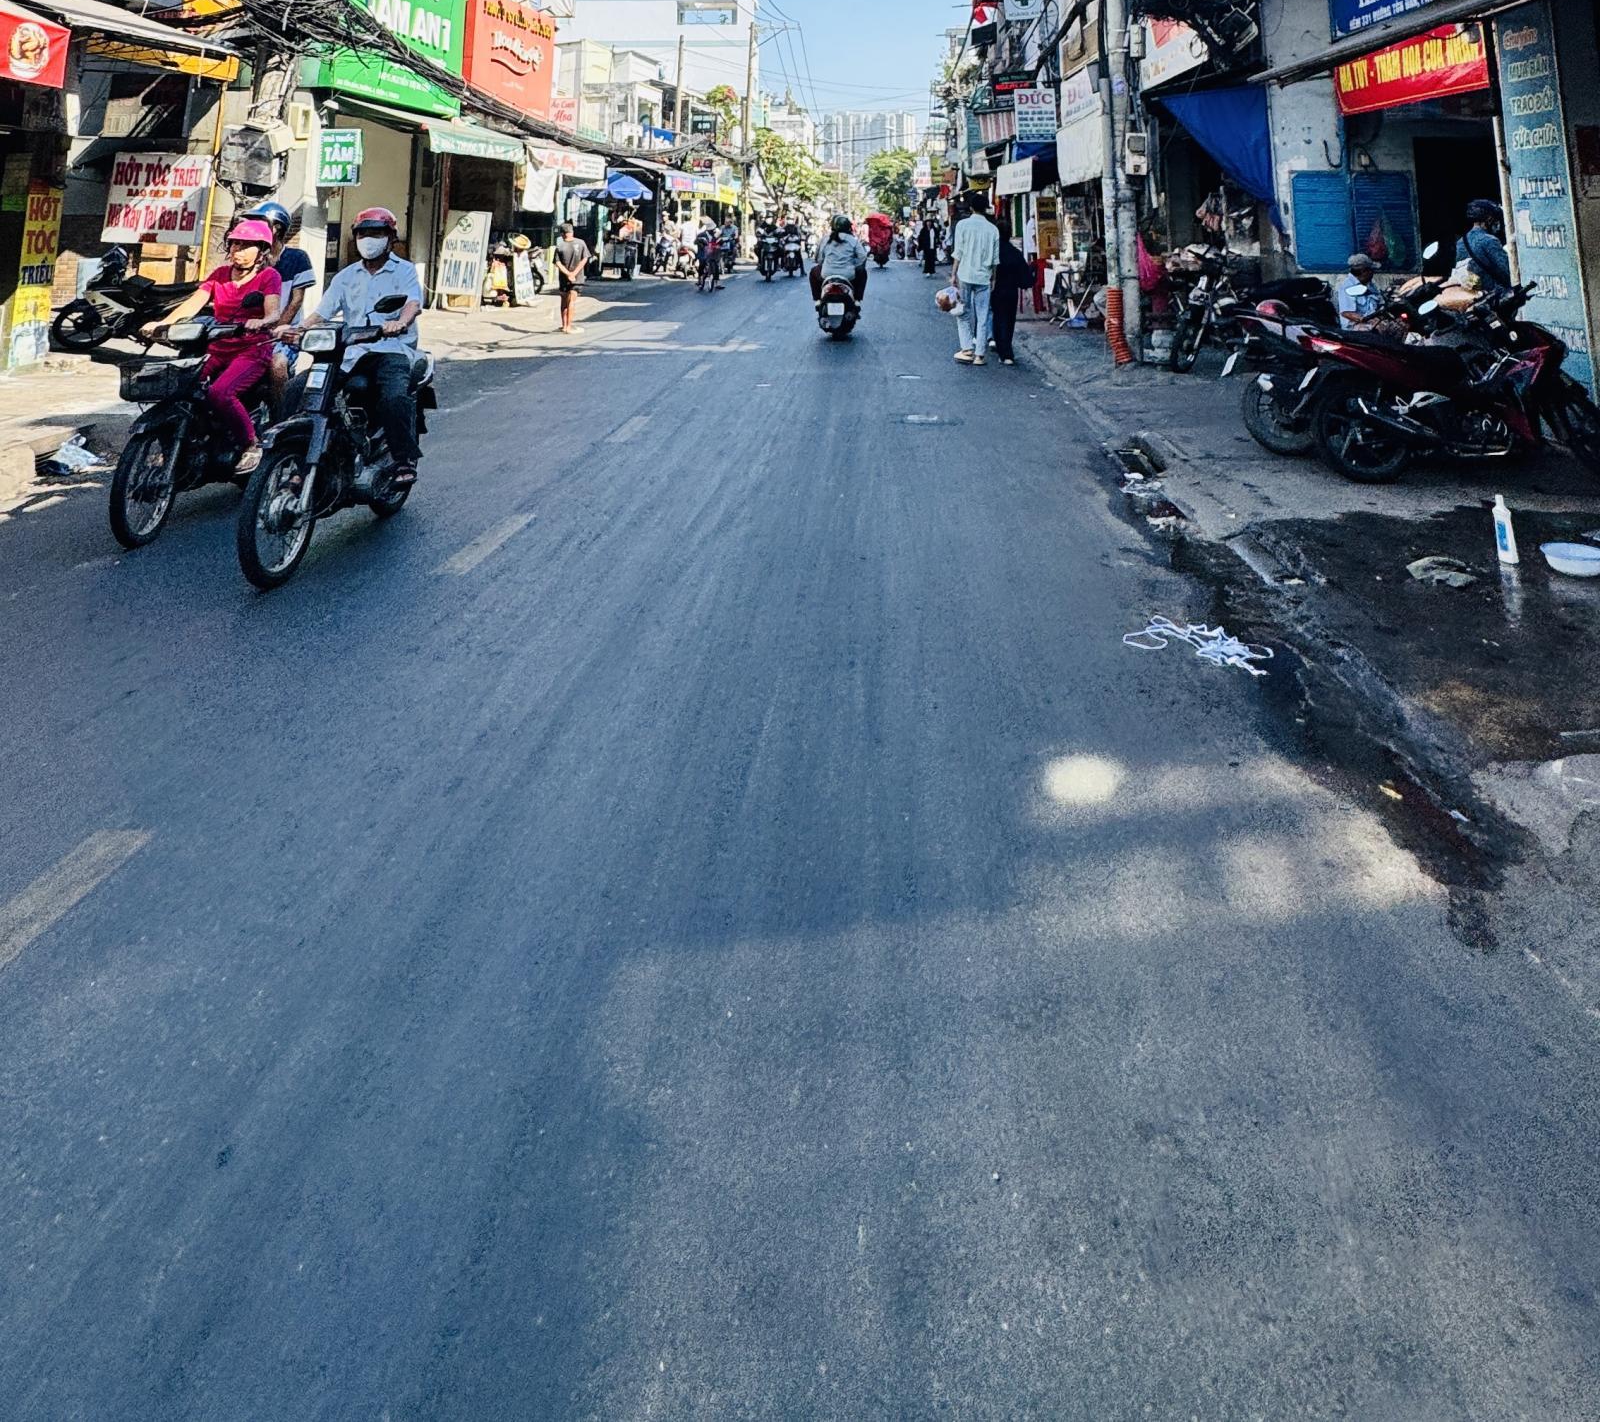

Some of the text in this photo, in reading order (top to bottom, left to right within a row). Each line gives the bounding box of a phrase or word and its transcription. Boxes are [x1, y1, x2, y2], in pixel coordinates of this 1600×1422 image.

[411, 7, 442, 51] AN
[1017, 90, 1053, 105] ĐỨC
[1511, 95, 1532, 116] TRAO
[324, 143, 354, 162] TÂM
[113, 155, 143, 186] HỚT
[144, 155, 172, 186] TÓC
[320, 164, 343, 180] AN
[25, 225, 58, 255] TÓC
[461, 259, 477, 289] AN
